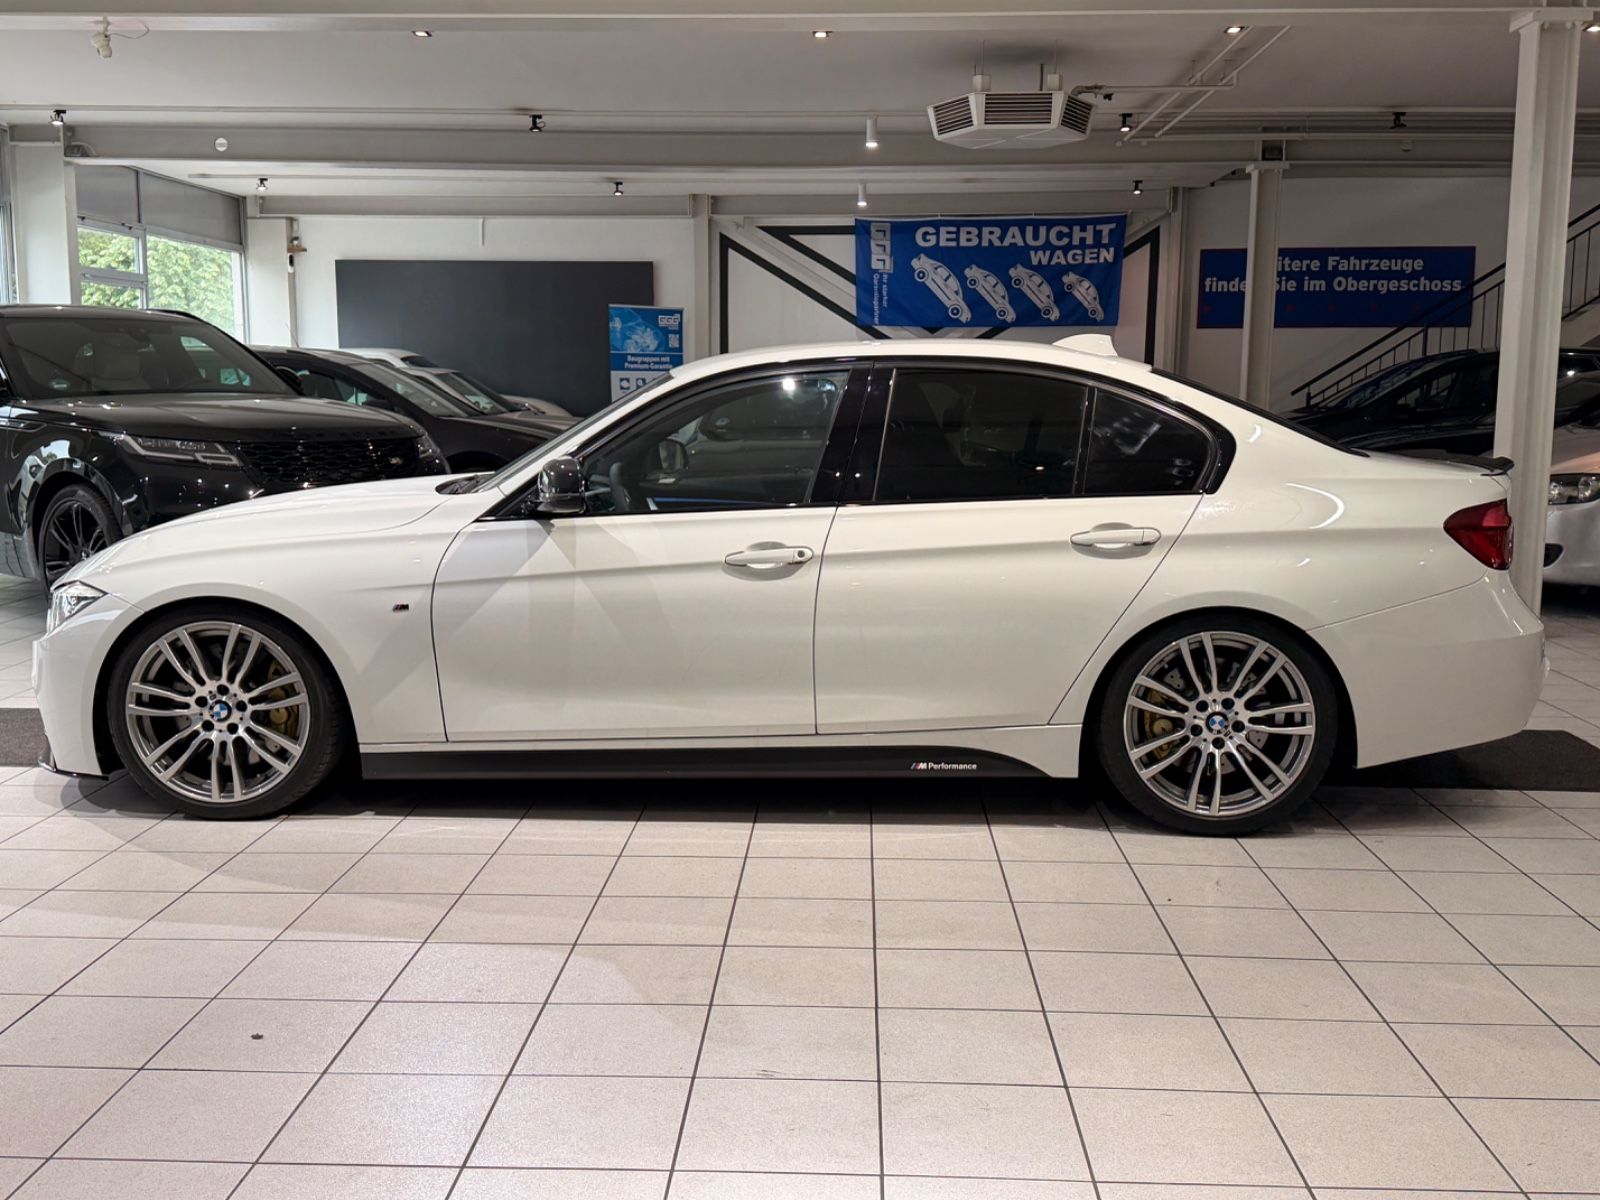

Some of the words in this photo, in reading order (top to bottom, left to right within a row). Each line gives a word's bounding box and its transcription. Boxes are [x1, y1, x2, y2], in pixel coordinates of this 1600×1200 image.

[914, 223, 1117, 247] GEBRAUCHT
[1030, 248, 1115, 265] WAGEN
[1277, 256, 1320, 272] itere
[1327, 256, 1425, 274] Fahrzeuge
[1204, 276, 1247, 293] finde
[1303, 276, 1326, 292] im
[928, 762, 977, 770] Performance
